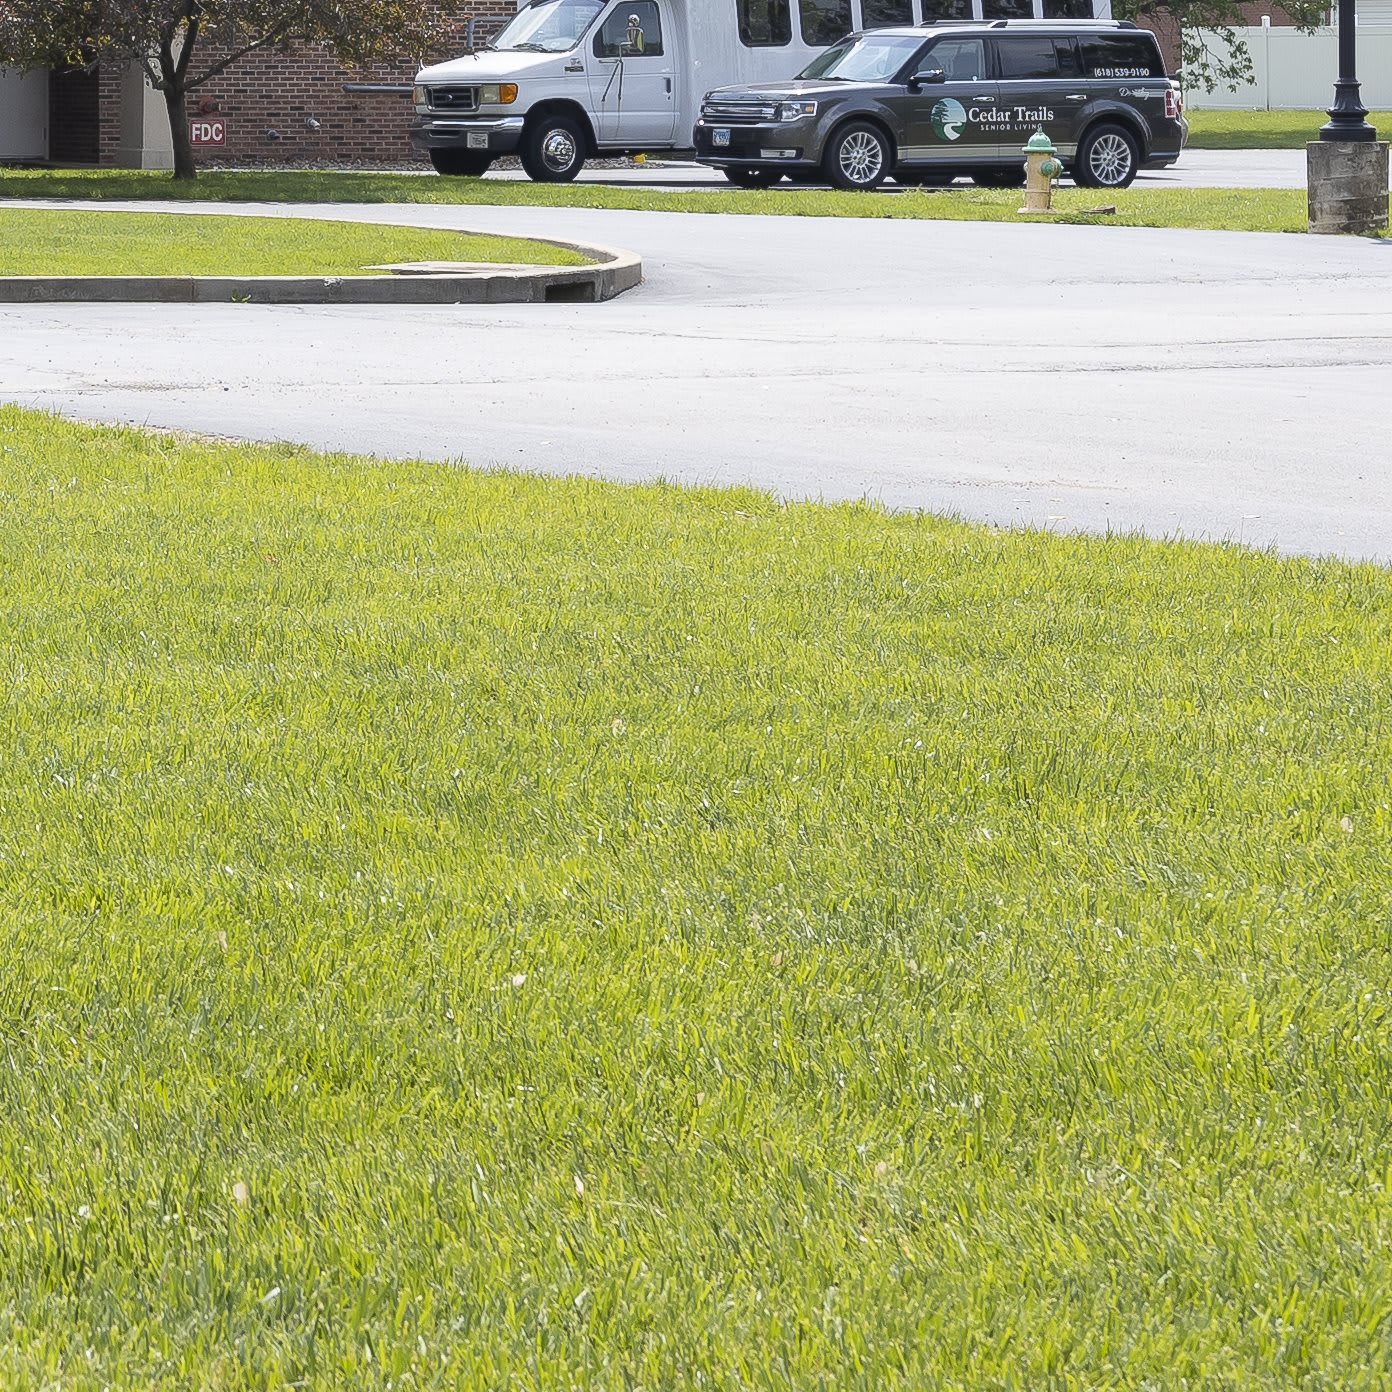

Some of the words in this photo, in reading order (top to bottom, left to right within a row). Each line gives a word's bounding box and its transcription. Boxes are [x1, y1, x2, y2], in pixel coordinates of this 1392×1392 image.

[1094, 67, 1114, 78] (618)
[968, 107, 1011, 123] Cedar
[1014, 106, 1054, 122] Trails
[191, 123, 223, 141] FDC
[980, 123, 1011, 131] SENIOR
[1014, 123, 1043, 131] LIVING
